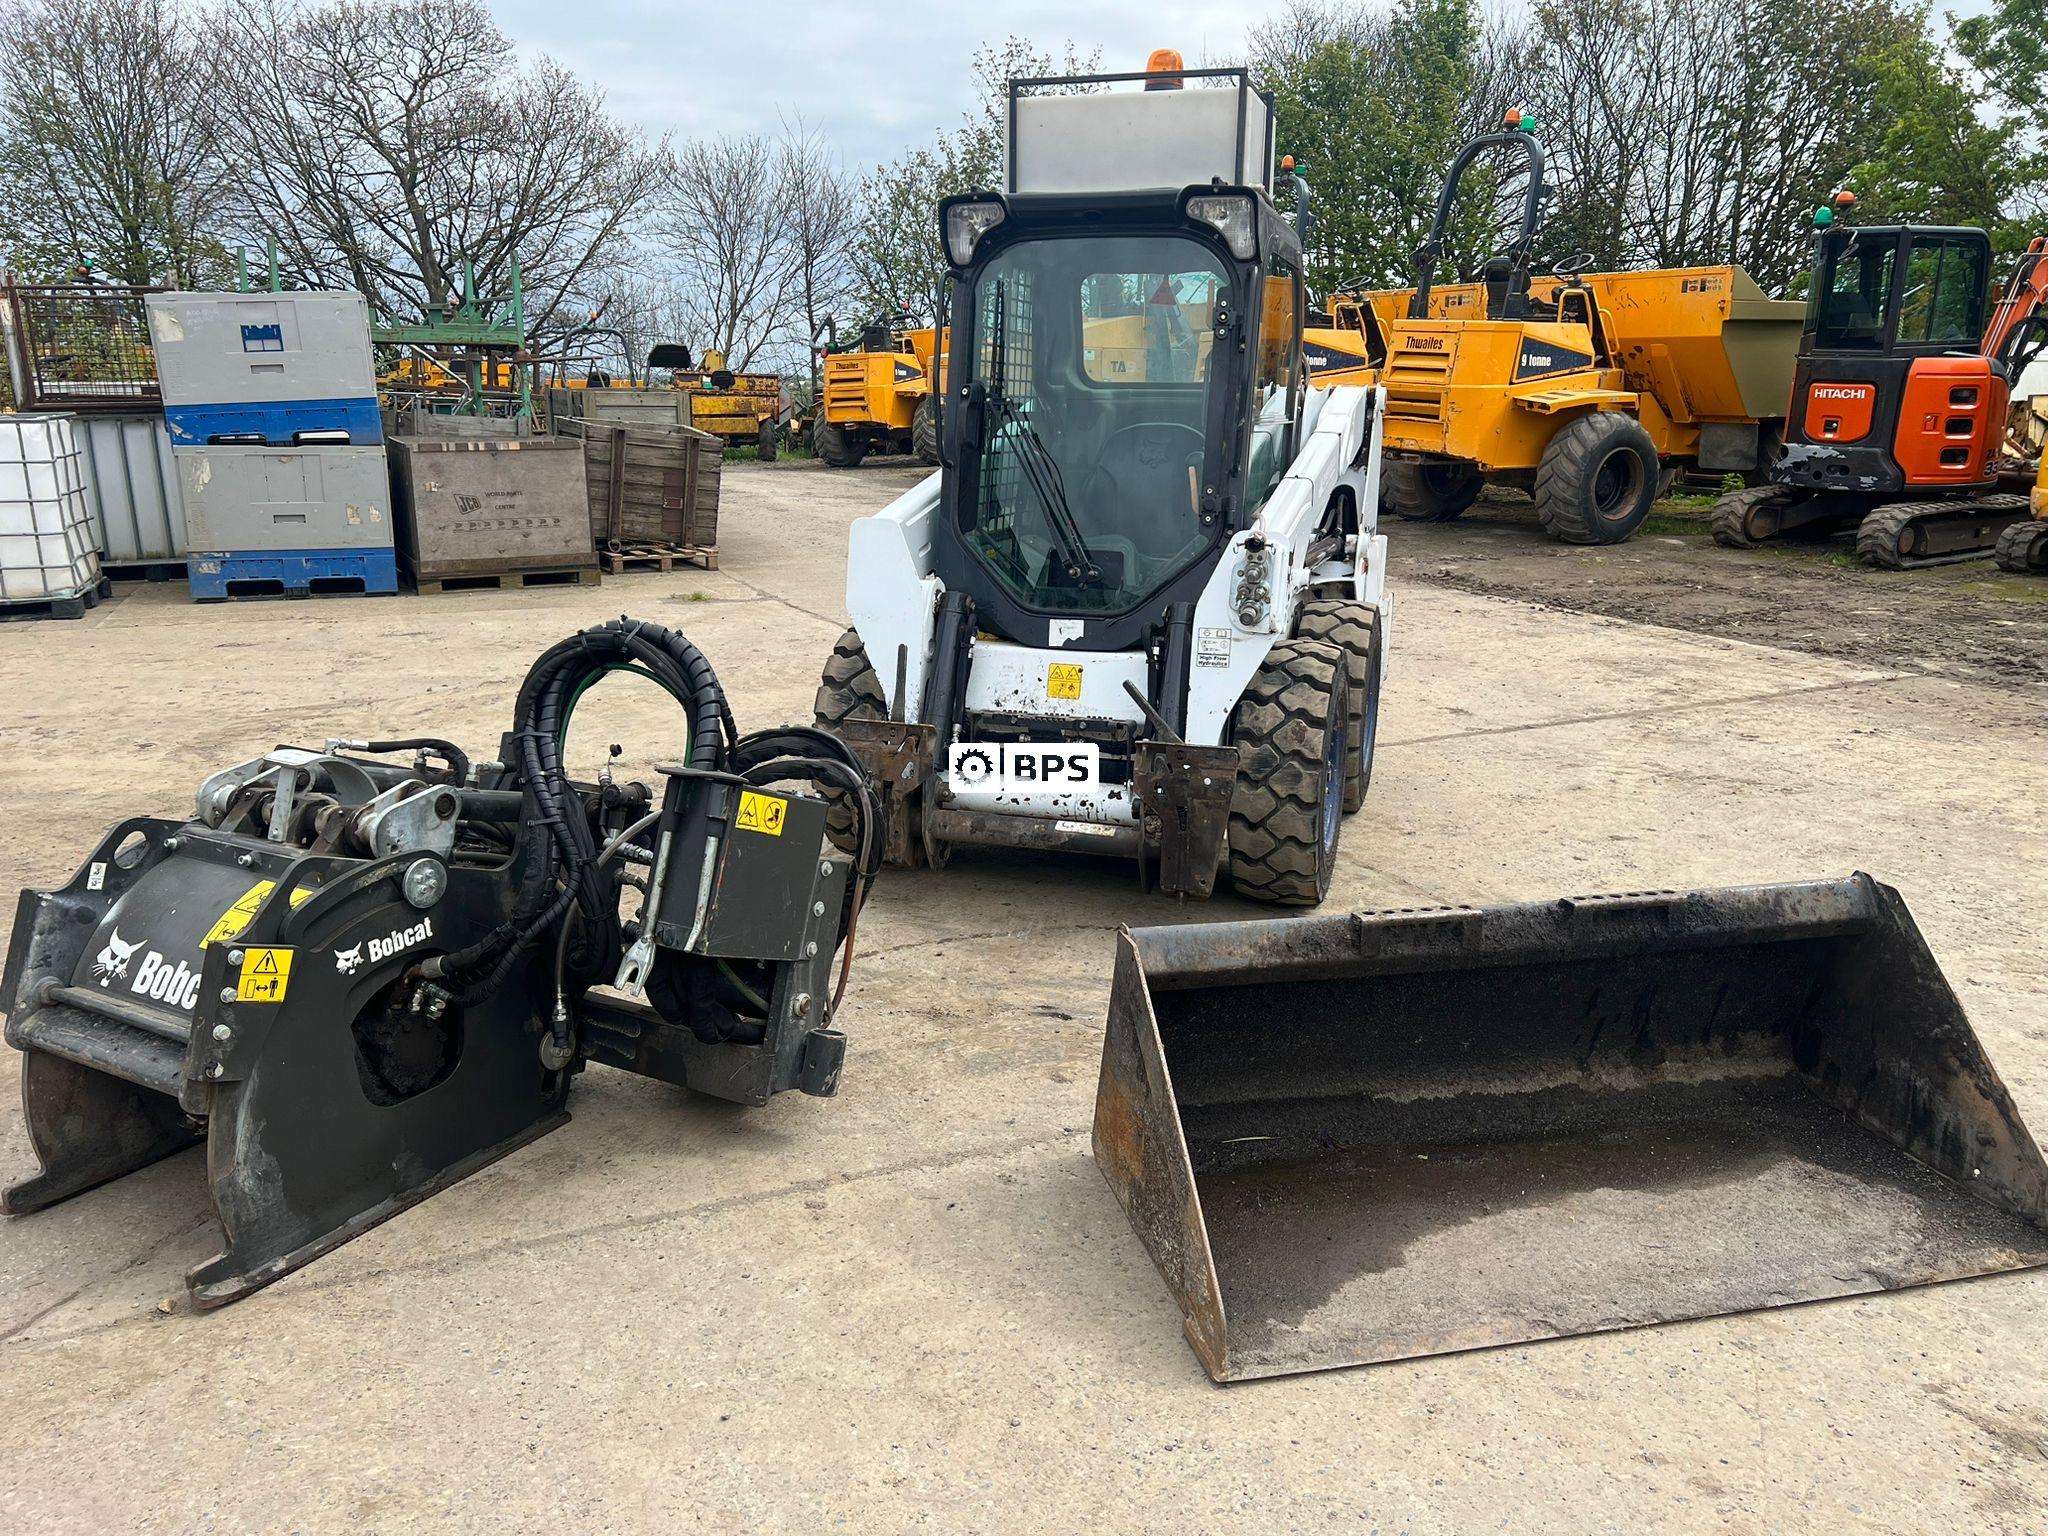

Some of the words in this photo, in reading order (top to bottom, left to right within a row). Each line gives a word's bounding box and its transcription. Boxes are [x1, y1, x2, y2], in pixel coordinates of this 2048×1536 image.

[1405, 336, 1443, 350] Thwaites
[1521, 354, 1527, 367] 9
[1529, 355, 1552, 367] tonne
[1814, 388, 1866, 399] HITACHI
[458, 495, 480, 513] JCB
[368, 916, 433, 963] Bobcat
